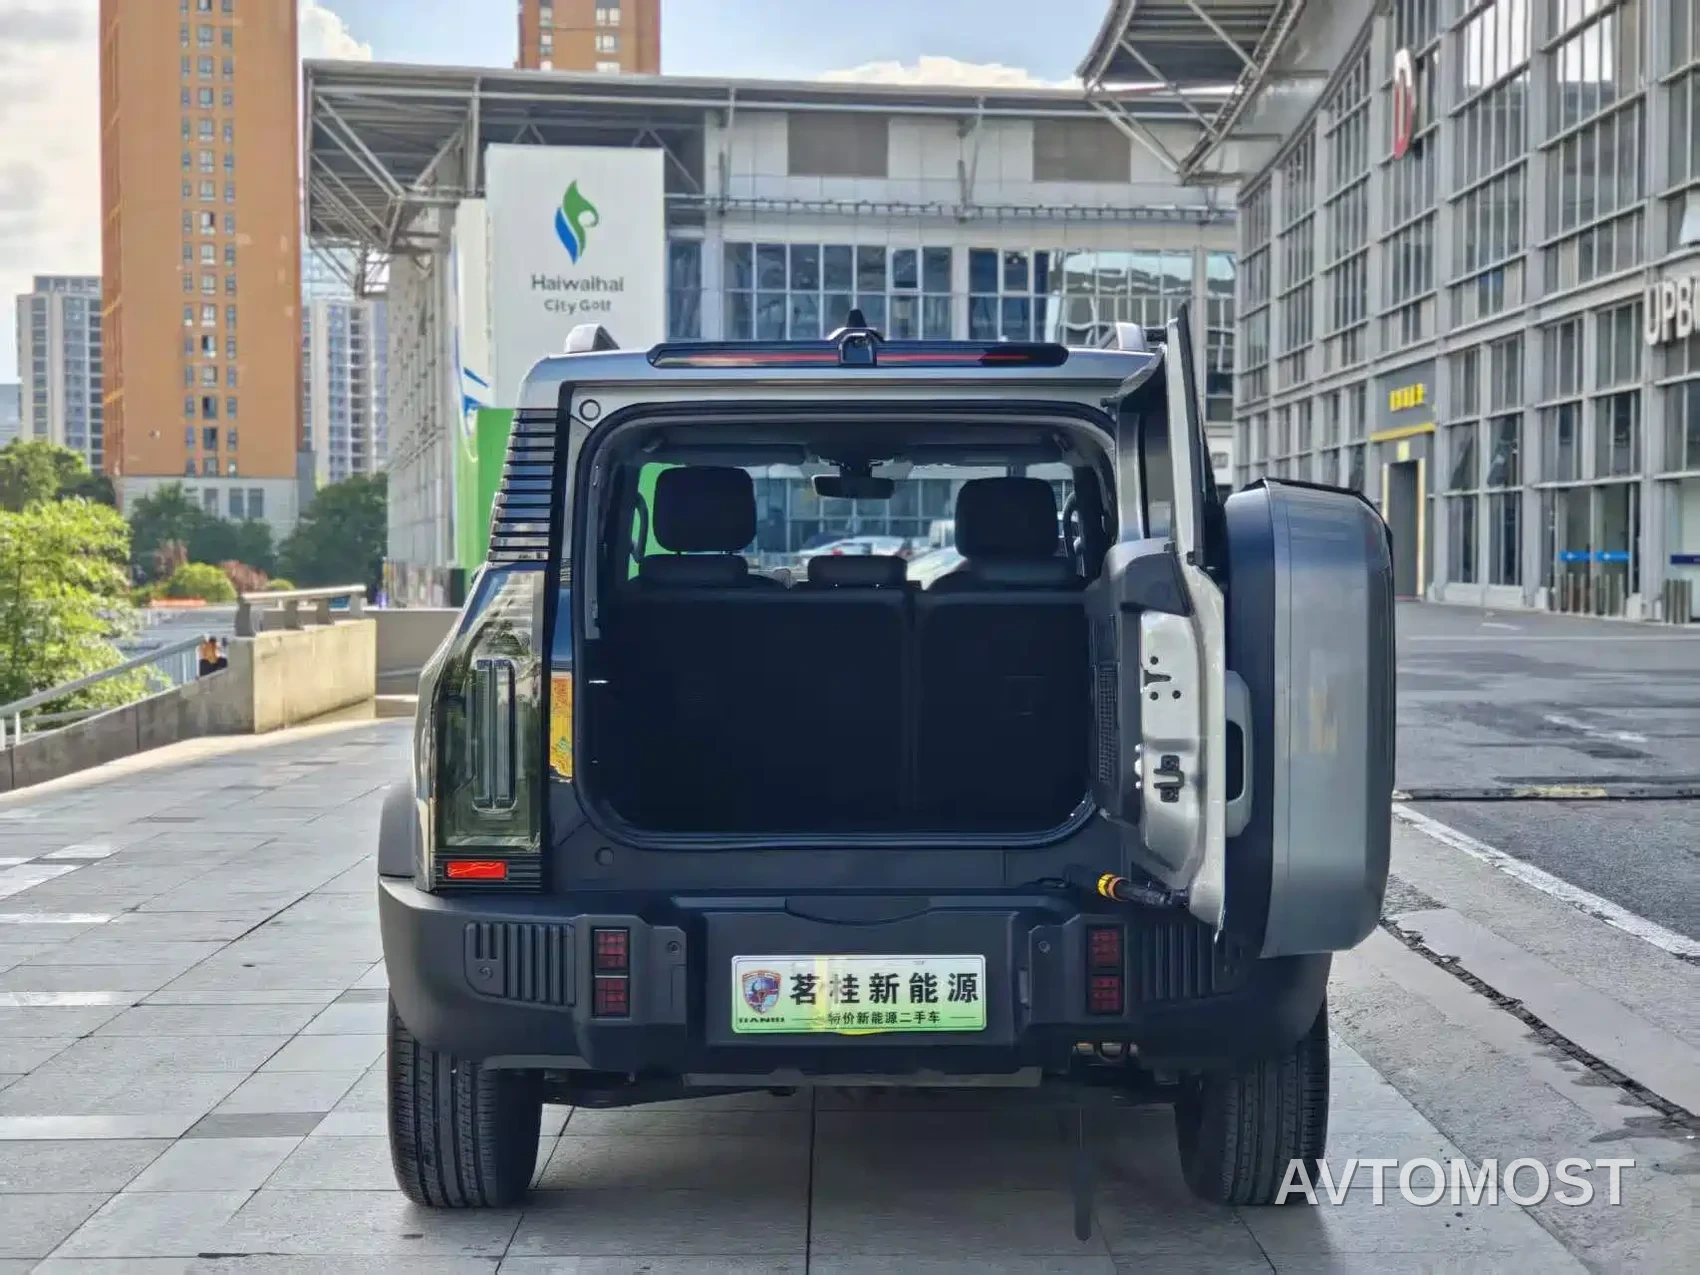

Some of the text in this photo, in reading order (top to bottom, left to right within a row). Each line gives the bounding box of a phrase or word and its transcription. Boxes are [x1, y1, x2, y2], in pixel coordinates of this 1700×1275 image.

[530, 273, 624, 292] Haiwaihai
[543, 299, 612, 315] City Golf
